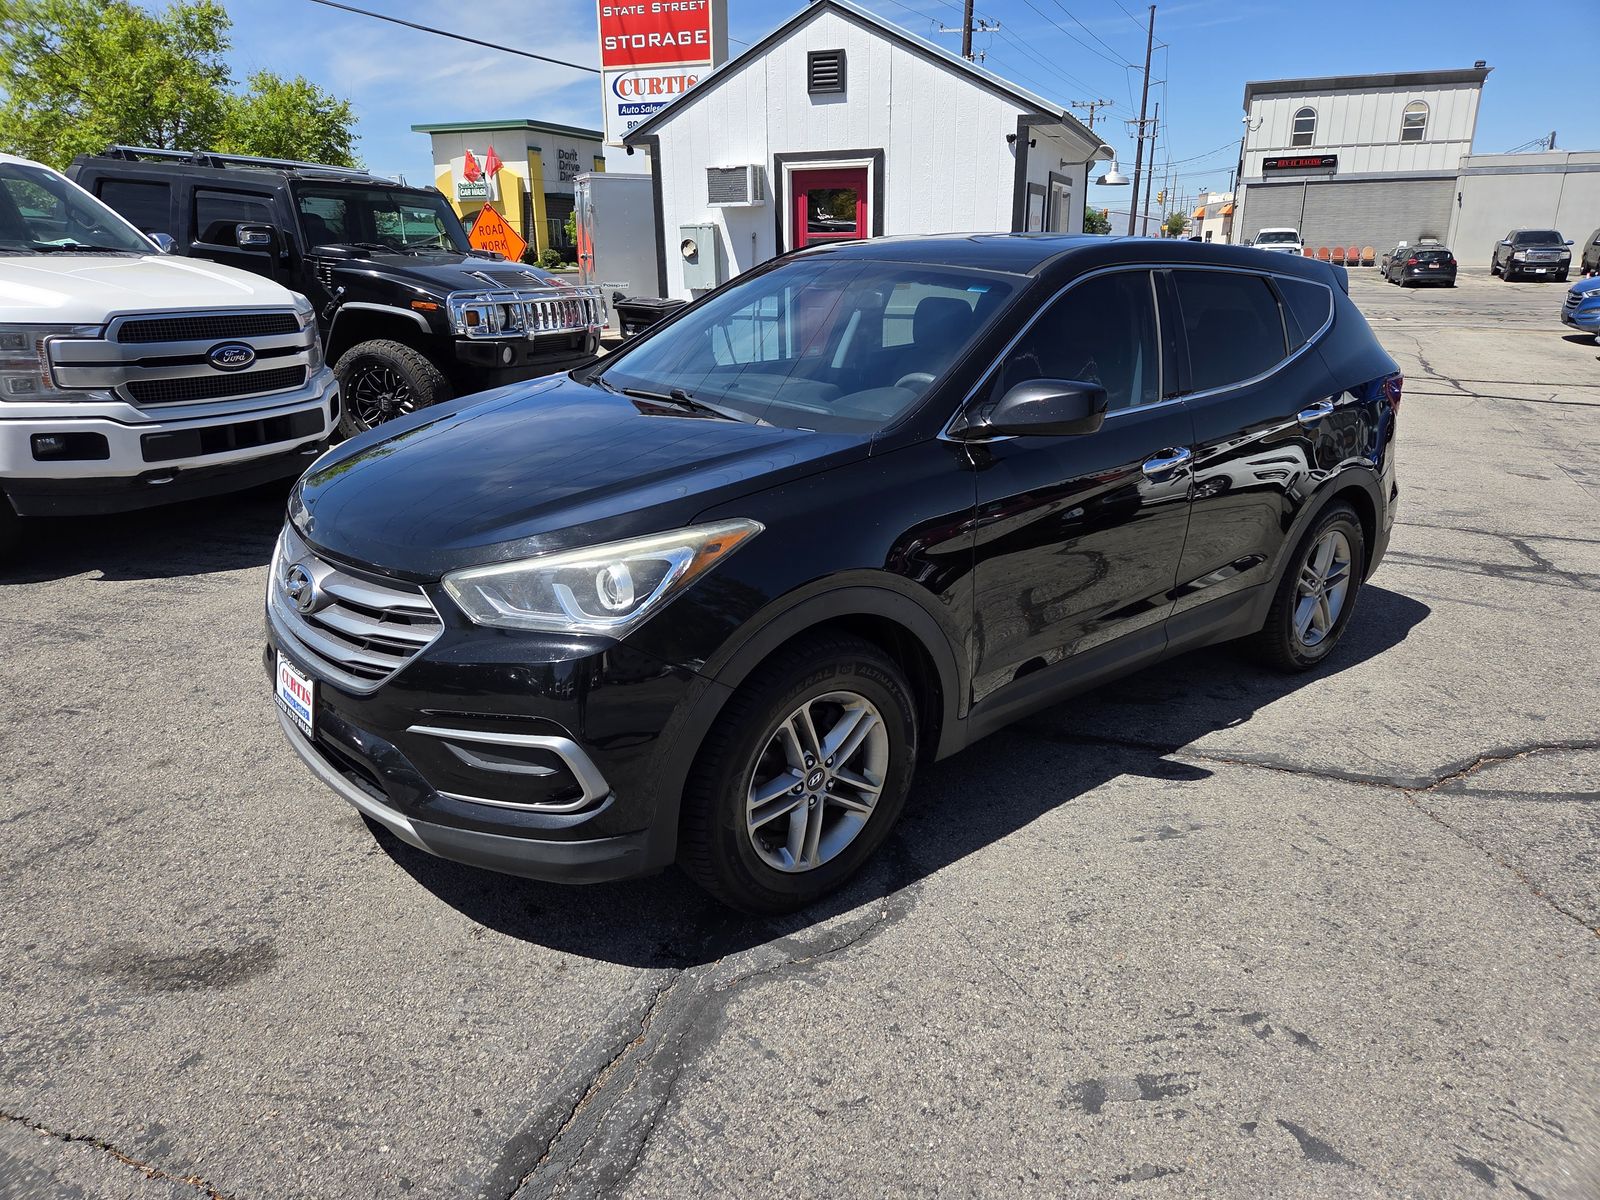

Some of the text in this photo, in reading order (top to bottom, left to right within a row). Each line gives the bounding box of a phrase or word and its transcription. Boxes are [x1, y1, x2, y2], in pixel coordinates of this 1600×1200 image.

[605, 29, 708, 50] STORAGE
[618, 74, 699, 97] CURTIS
[621, 105, 639, 114] Auto
[560, 160, 580, 171] Drive
[461, 188, 471, 196] CAR
[478, 223, 504, 236] ROAD
[481, 239, 508, 251] WORK
[223, 350, 245, 362] Ford
[282, 667, 312, 706] CURTIS
